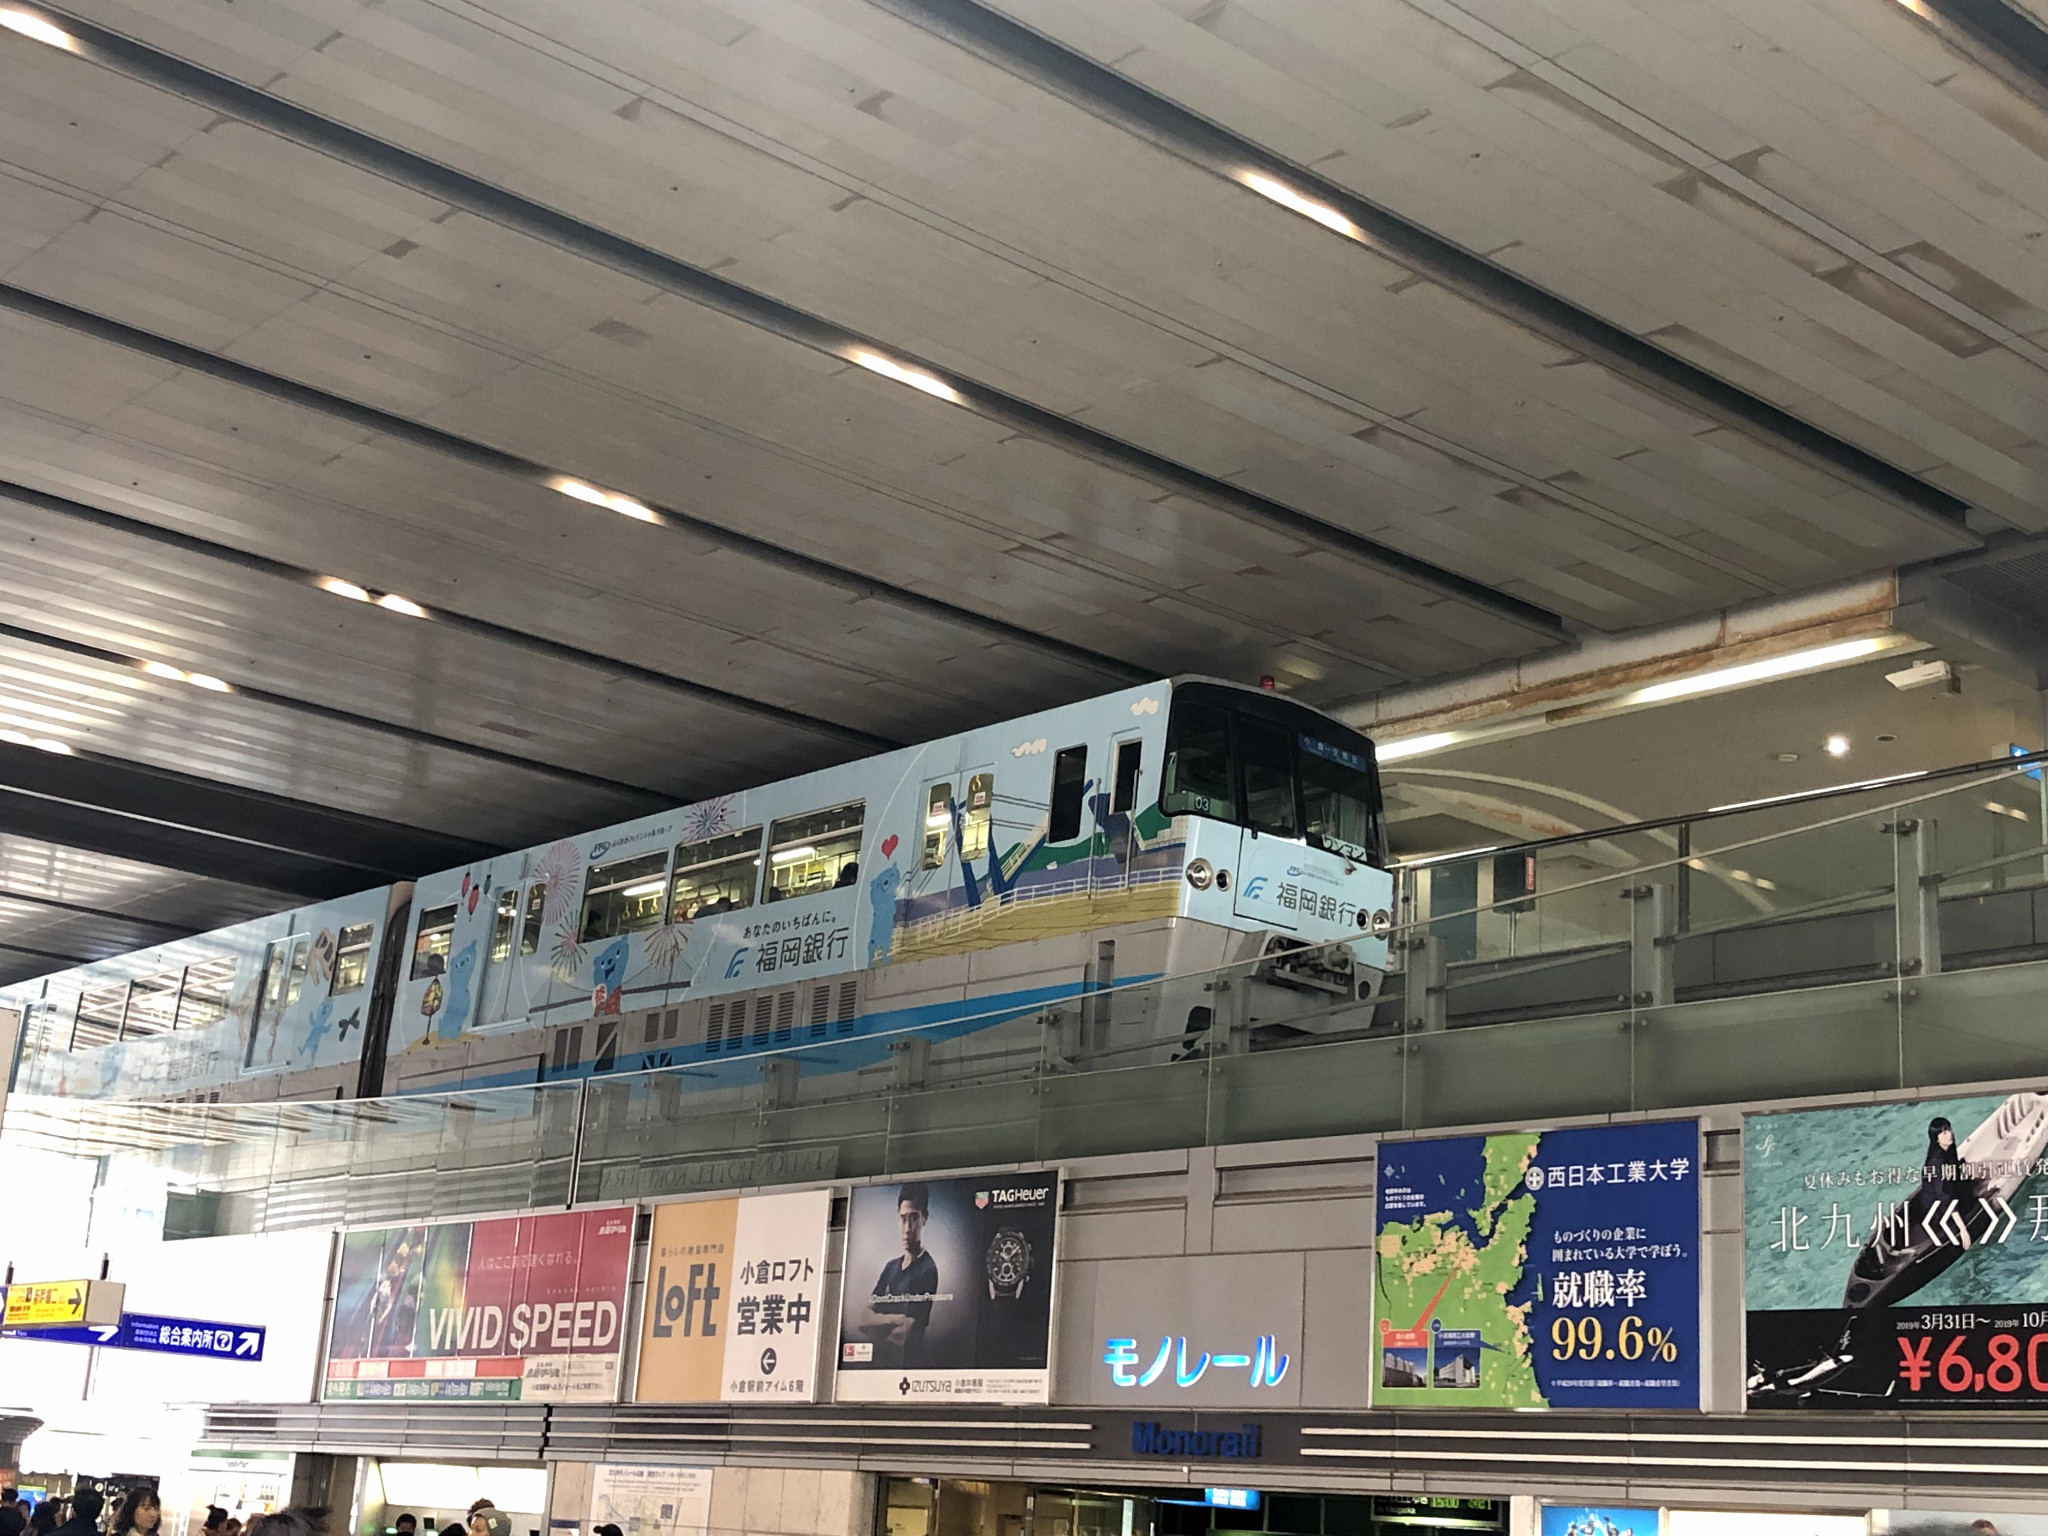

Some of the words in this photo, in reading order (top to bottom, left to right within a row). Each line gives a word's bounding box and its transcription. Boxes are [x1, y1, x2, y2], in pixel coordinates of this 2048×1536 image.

[1195, 795, 1209, 812] 03
[1276, 882, 1356, 928] 福岡銀行
[743, 911, 836, 939] あなたのいちばんに。
[756, 927, 849, 973] 福岡銀行
[1547, 1157, 1690, 1188] 西日本工業大学
[1554, 1226, 1647, 1244] ものづくりの企業に
[1769, 1199, 1910, 1252] 北九州
[739, 1258, 814, 1285] 小倉ロフト
[1552, 1243, 1688, 1262] 囲まれている大学で学ぼう。
[1551, 1268, 1647, 1308] 就職率
[429, 1304, 503, 1350] VIVID
[509, 1300, 618, 1350] SPEED
[736, 1293, 811, 1336] 営業中
[158, 1325, 214, 1349] 総合案内所
[1551, 1315, 1678, 1363] 99.6%
[1103, 1333, 1290, 1388] モノレール
[1131, 1420, 1261, 1459] Monorail
